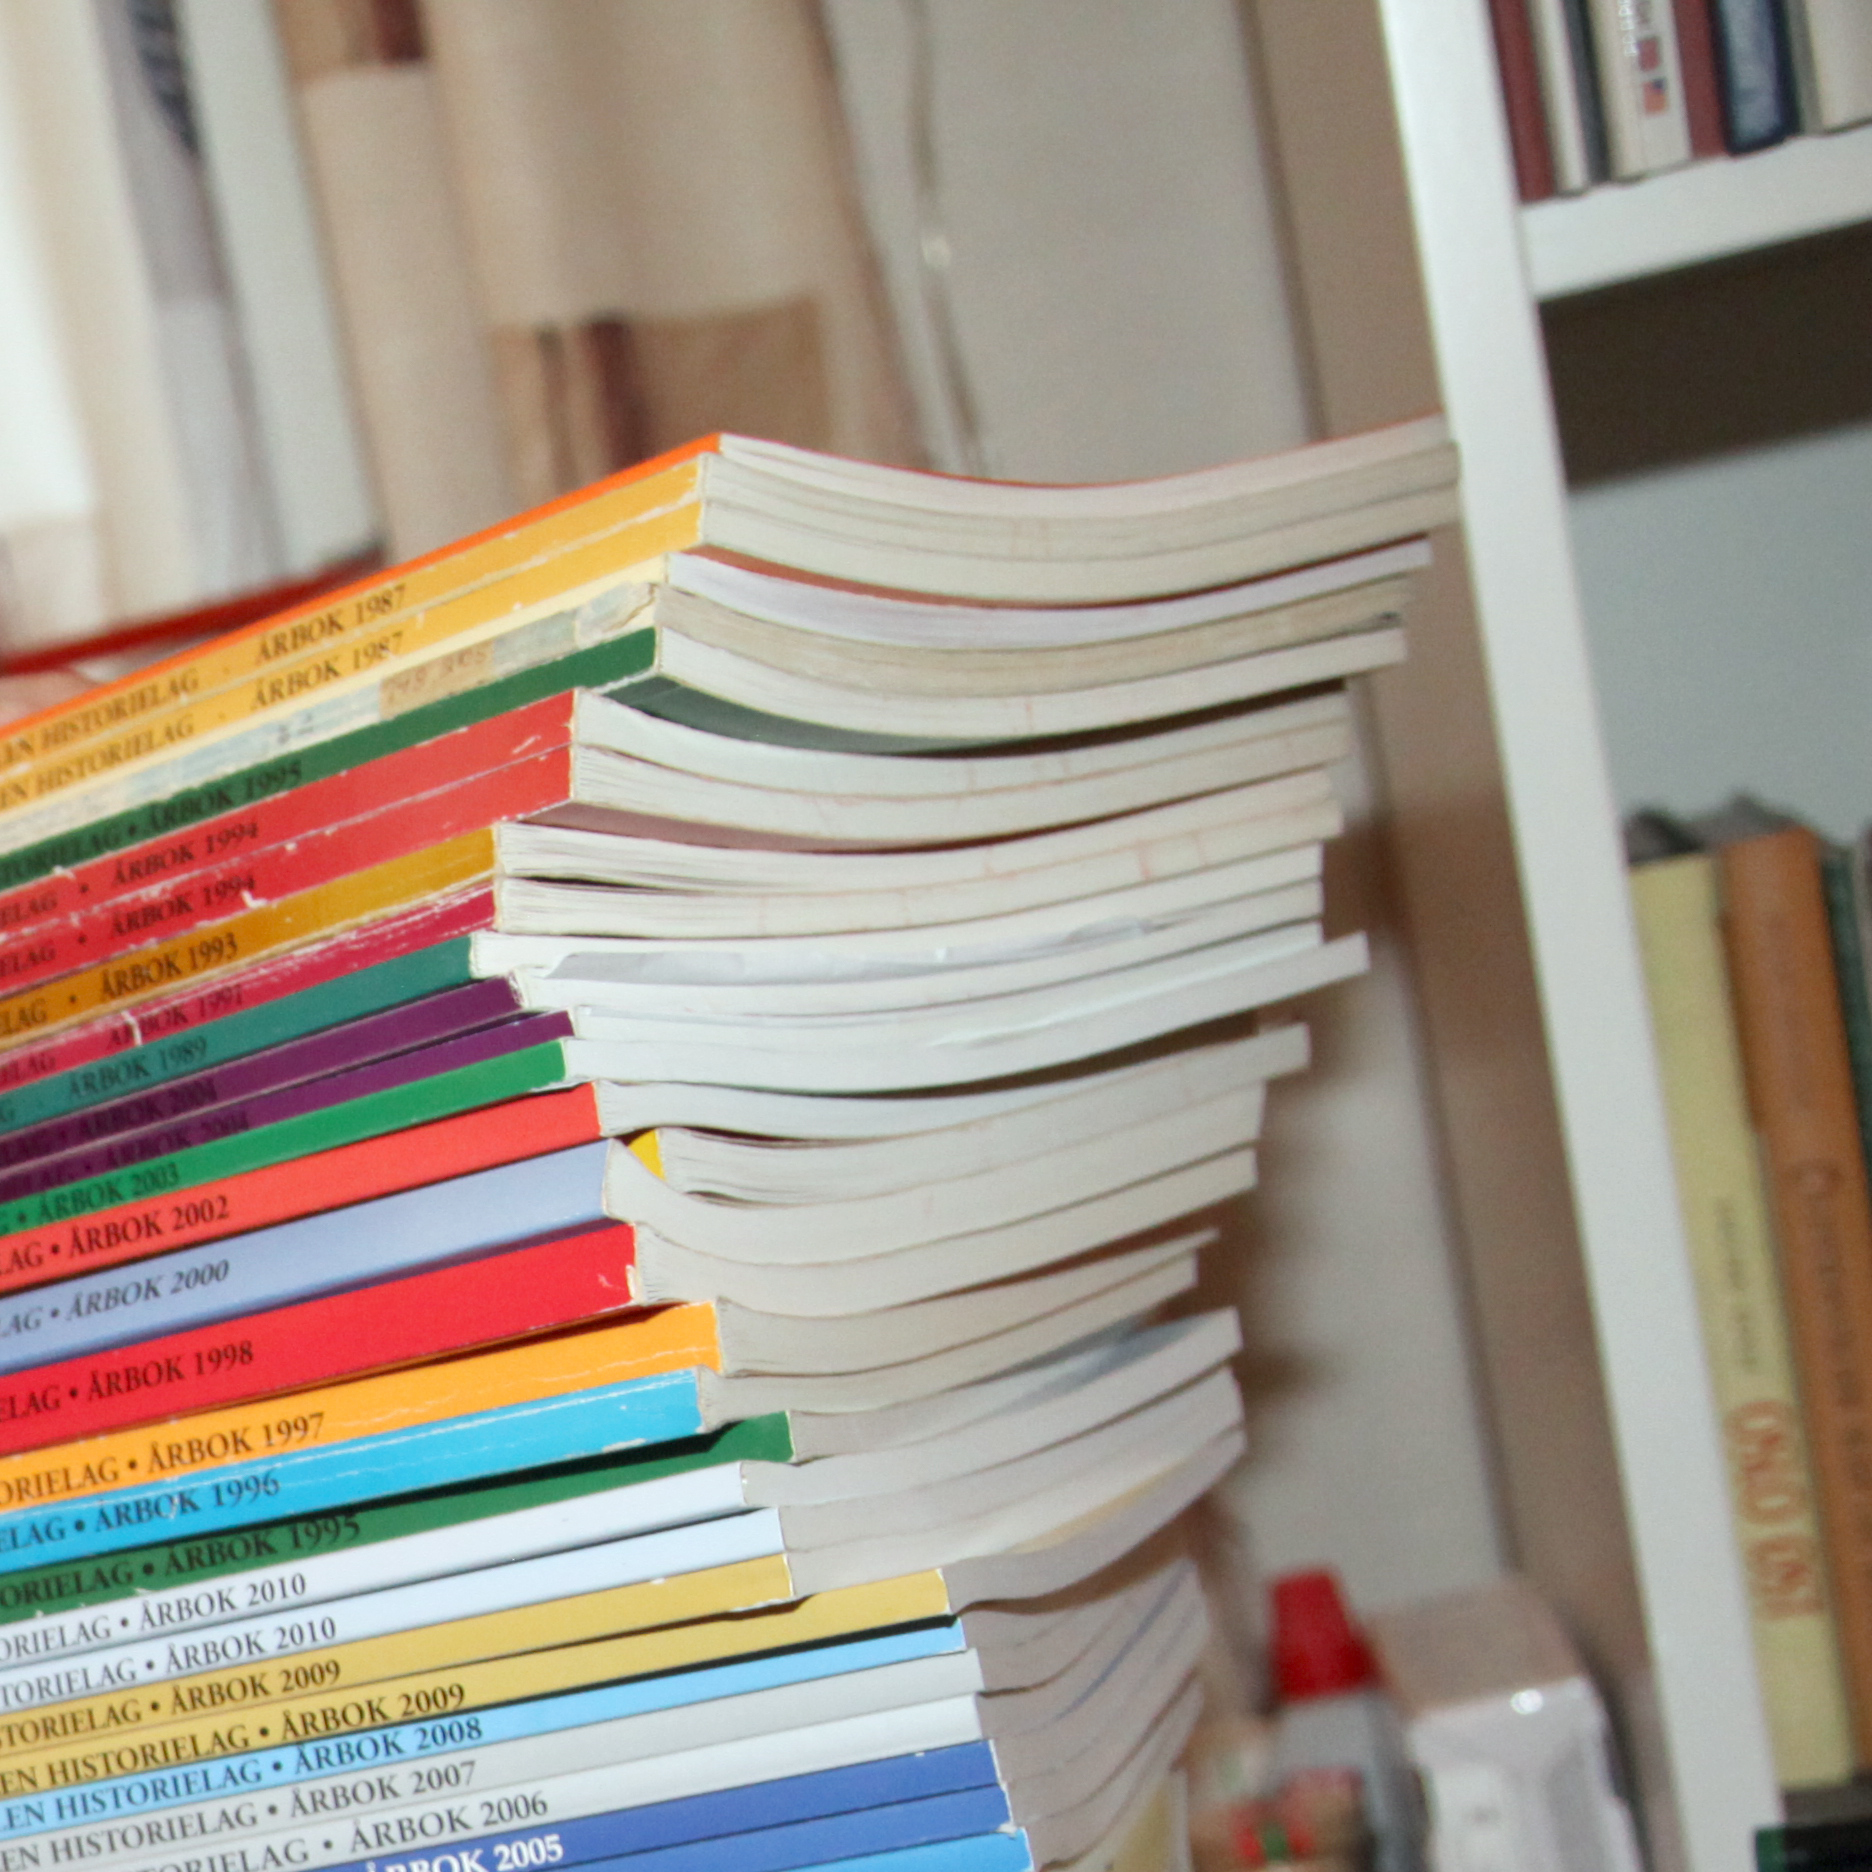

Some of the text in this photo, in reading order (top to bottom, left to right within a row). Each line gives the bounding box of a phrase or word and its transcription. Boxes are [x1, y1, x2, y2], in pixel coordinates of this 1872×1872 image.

[63, 1212, 164, 1259] ÅRBOK
[168, 1195, 232, 1233] 2002
[65, 1276, 163, 1320] ÅRBOK
[166, 1259, 232, 1295] 2000
[82, 1355, 188, 1402] ÅRBOK
[190, 1339, 256, 1377] 1998
[143, 1427, 254, 1473] ÅRBOK
[259, 1411, 328, 1448] 1997
[91, 1489, 203, 1534] ÅRBOK
[211, 1472, 282, 1509] 1996
[159, 1530, 277, 1577] ÅRBOK
[284, 1513, 362, 1551] 1995
[135, 1587, 239, 1631] ÅRBOK
[245, 1572, 307, 1607] 2010
[162, 1631, 266, 1674] ÅRBOK
[272, 1616, 337, 1651] 2010
[167, 1672, 270, 1714] ÅRBOK
[275, 1658, 342, 1693] 2009
[46, 1724, 252, 1786] HISTORIELAG
[276, 1697, 391, 1741] ÅRBOK
[396, 1682, 467, 1717] 2009
[53, 1759, 262, 1821] HISTORIELAG
[290, 1731, 405, 1775] ÅRBOK
[412, 1716, 483, 1751] 2008
[50, 1803, 259, 1865] HISTORIELAG
[285, 1776, 401, 1819] ÅRBOK
[409, 1761, 479, 1795] 2007
[345, 1807, 471, 1854] ÅRBOK
[479, 1791, 549, 1828] 2006
[494, 1836, 564, 1872] 2005
